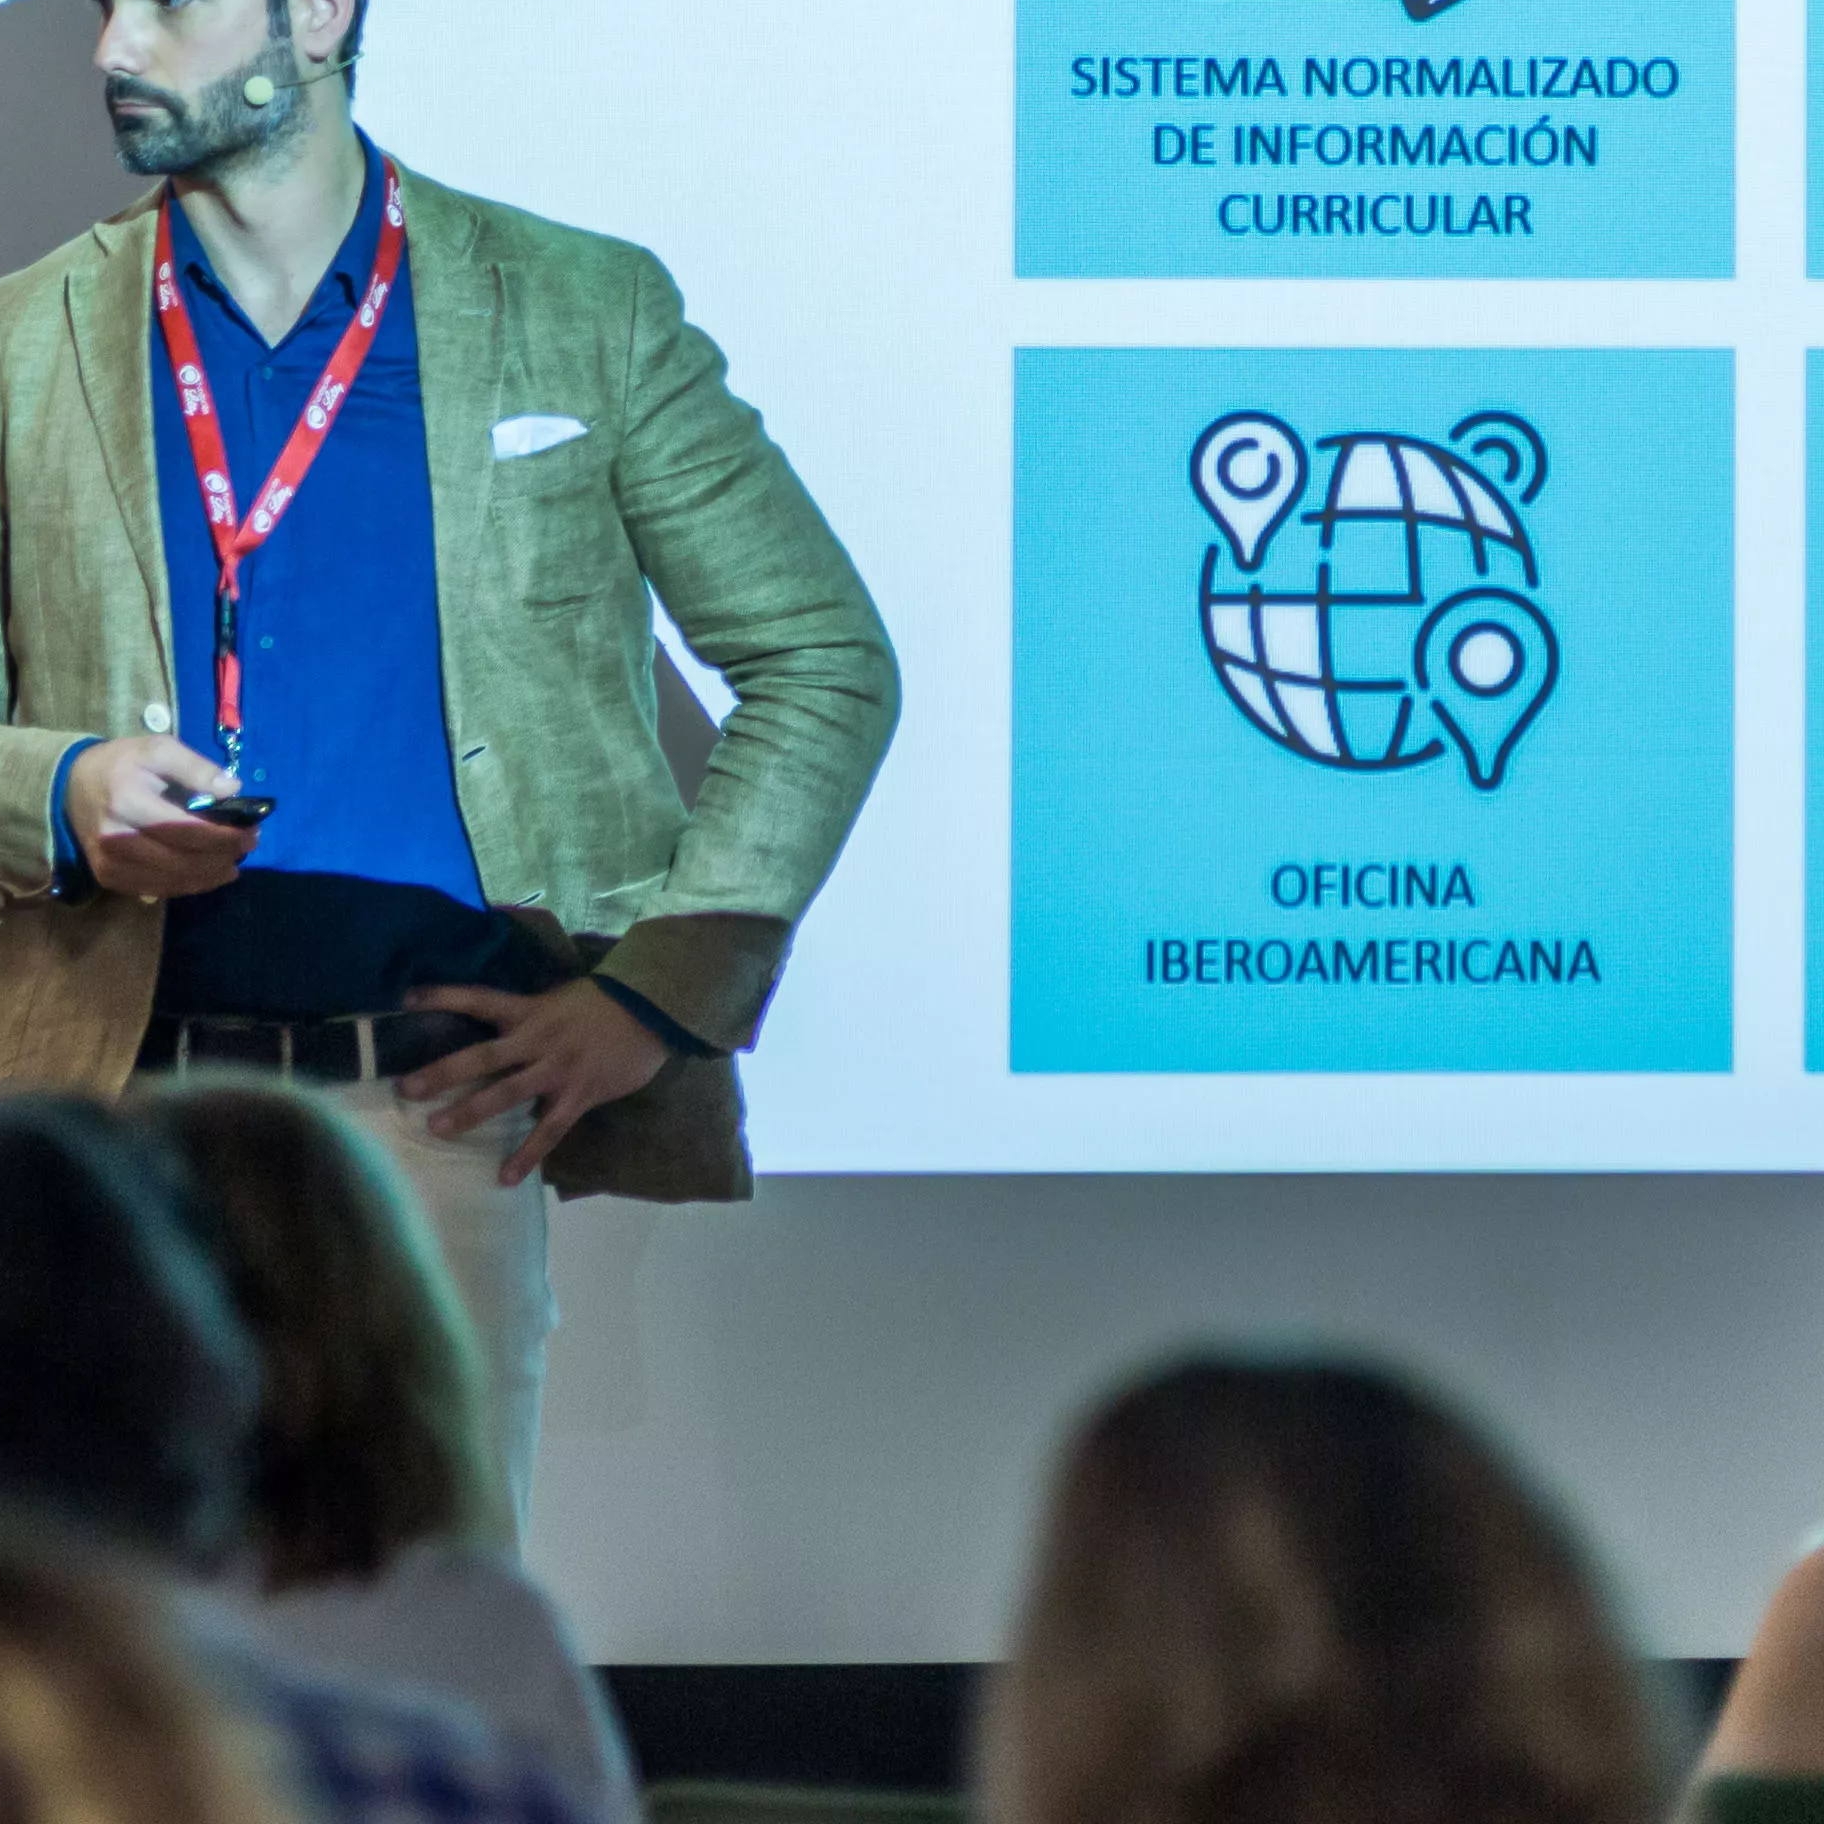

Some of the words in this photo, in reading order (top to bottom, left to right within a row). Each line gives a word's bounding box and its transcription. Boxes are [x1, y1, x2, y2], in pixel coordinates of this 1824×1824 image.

[1072, 57, 1286, 96] SISTEMA
[1305, 57, 1679, 98] NORMALIZADO
[1154, 124, 1216, 164] DE
[1234, 115, 1596, 166] INFORMACIÓN
[1219, 194, 1532, 235] CURRICULAR
[1271, 864, 1475, 907] OFICINA
[1147, 940, 1601, 983] IBEROAMERICANA
